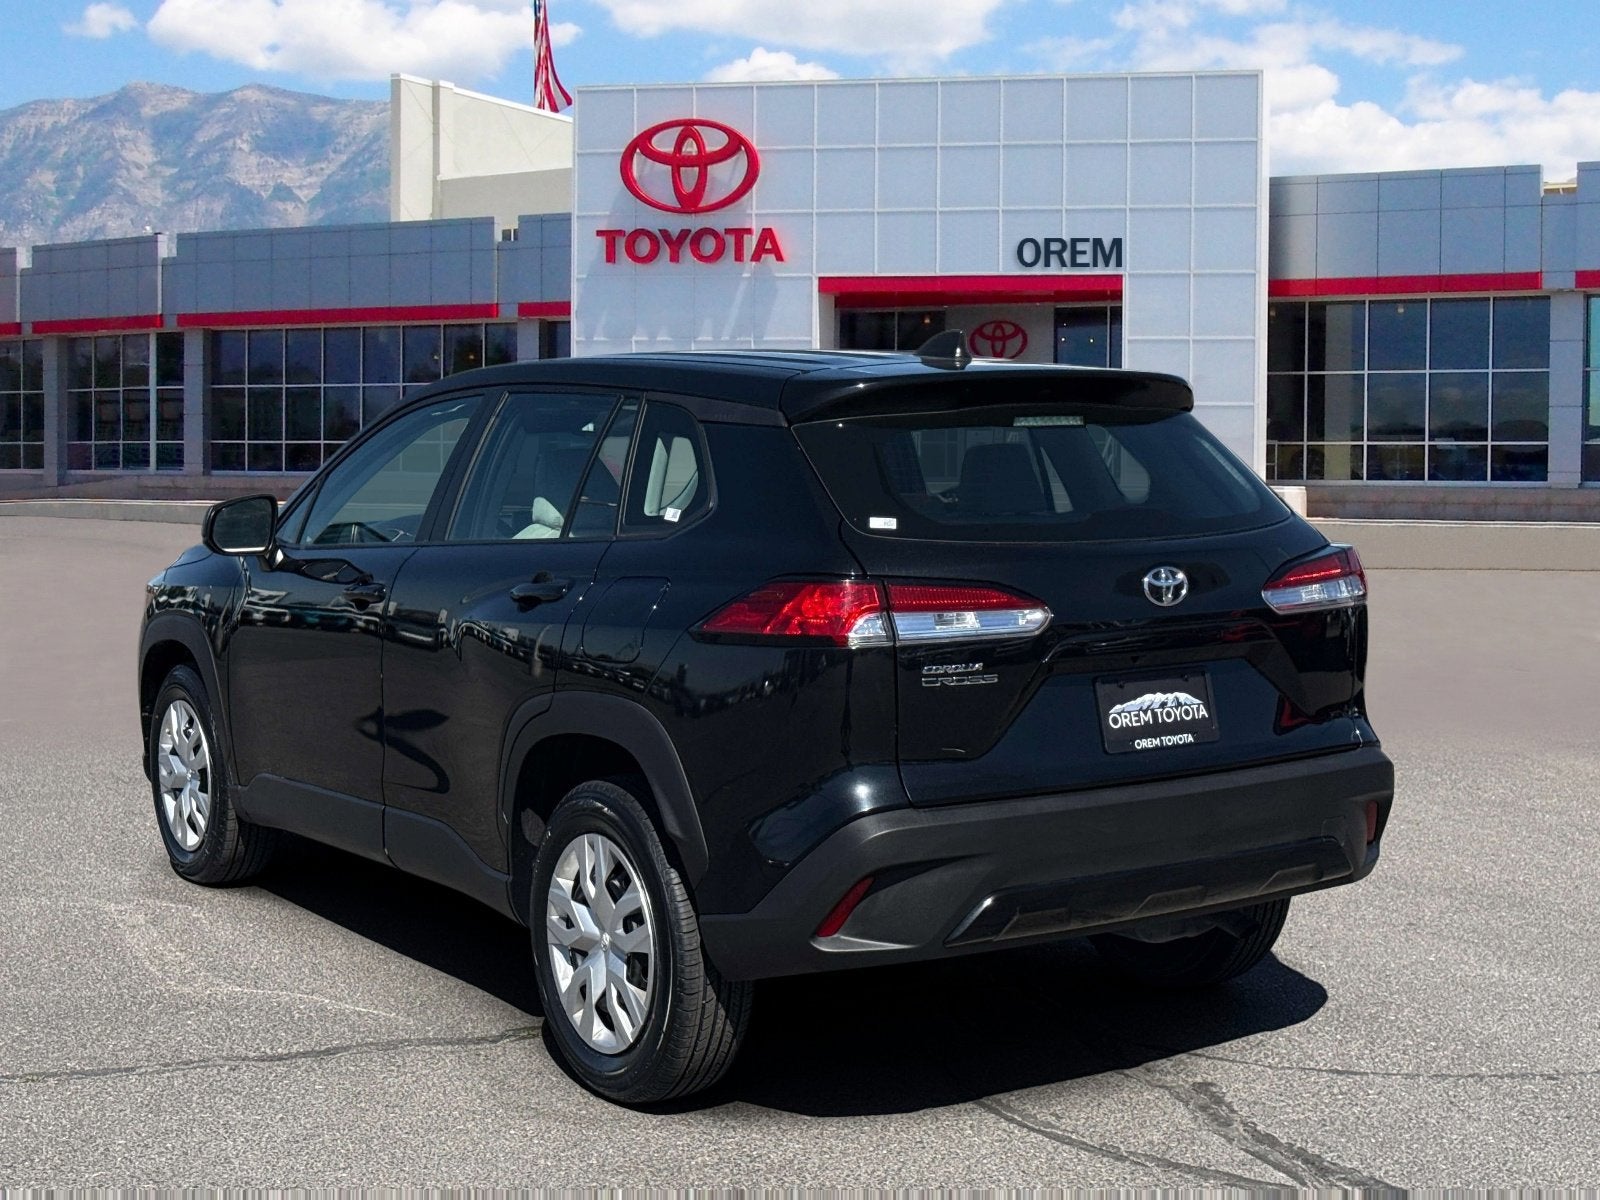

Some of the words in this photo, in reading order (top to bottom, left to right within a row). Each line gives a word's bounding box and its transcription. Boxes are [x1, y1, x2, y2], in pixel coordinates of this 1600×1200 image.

[596, 227, 784, 264] TOYOTA
[1017, 237, 1122, 268] OREM
[922, 674, 998, 687] CROSS
[1109, 710, 1153, 728] OREM
[1154, 704, 1208, 723] TOYOTA
[1134, 737, 1160, 749] OREM
[1161, 733, 1194, 746] TOYOTA
